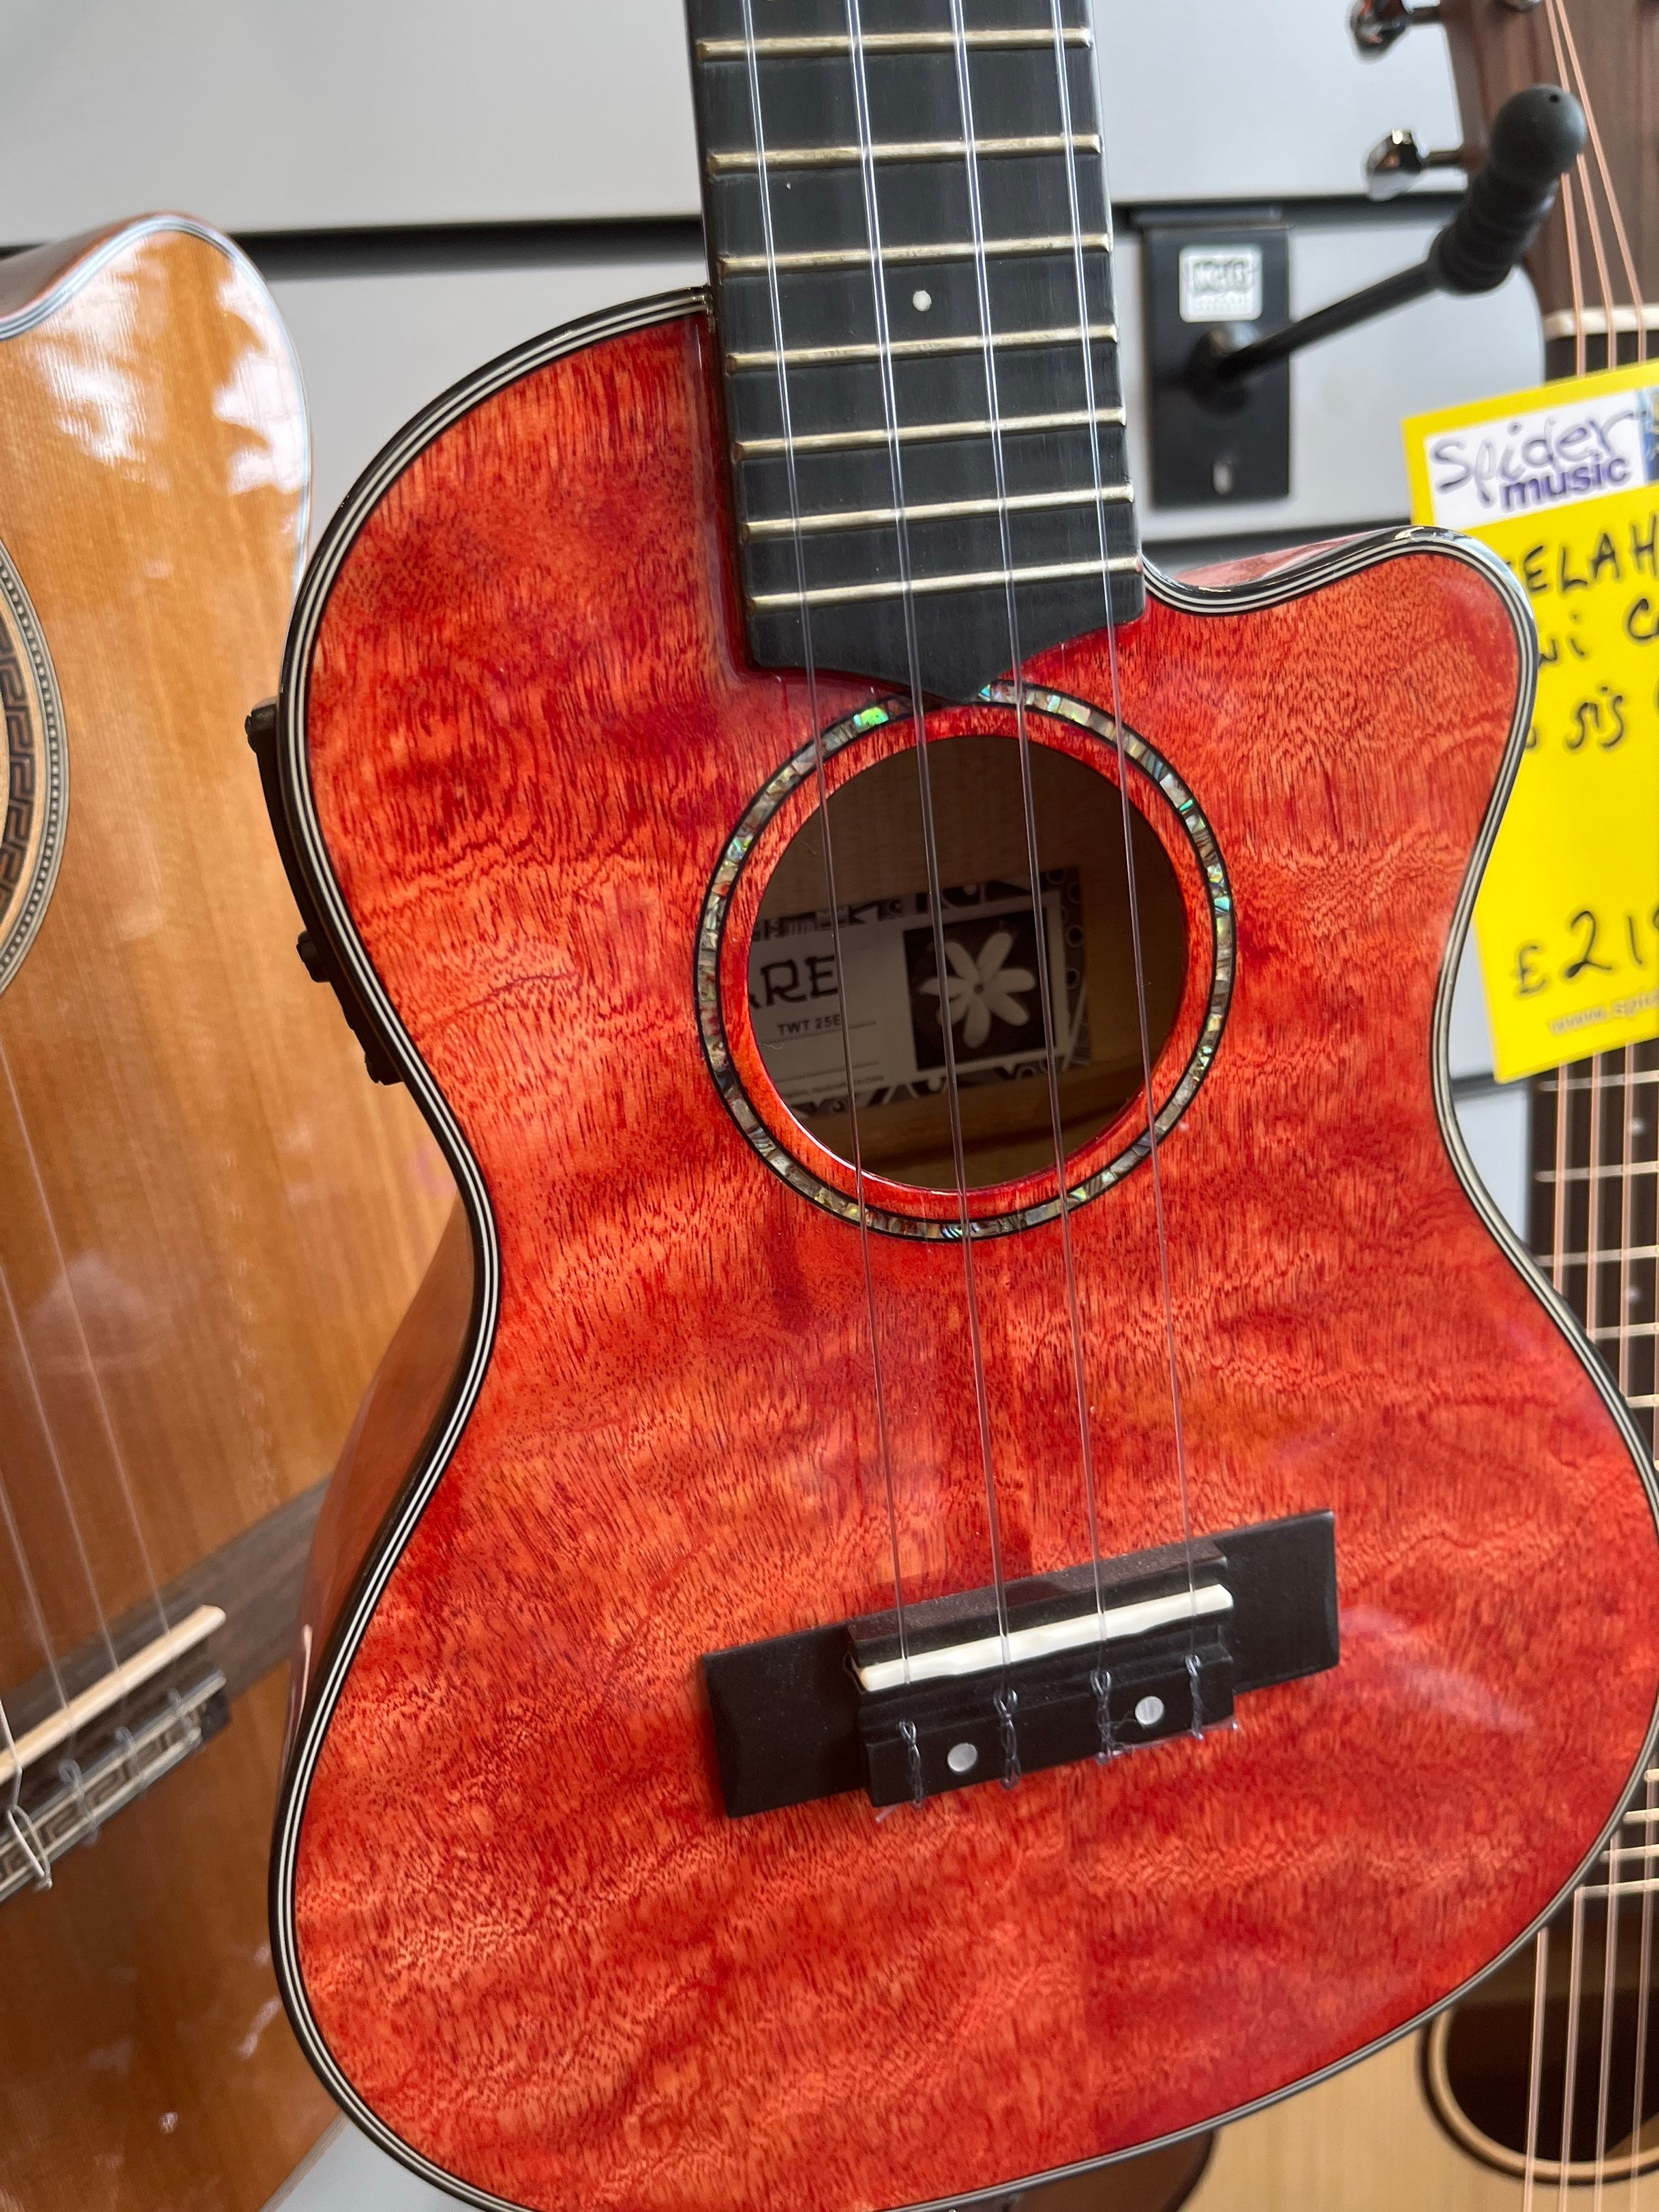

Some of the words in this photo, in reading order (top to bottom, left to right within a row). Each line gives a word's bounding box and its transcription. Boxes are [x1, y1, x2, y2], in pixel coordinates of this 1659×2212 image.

[1502, 454, 1628, 510] music
[1506, 514, 1659, 594] ELAH
[777, 1020, 810, 1036] TWT
[815, 1015, 841, 1030] 25E
